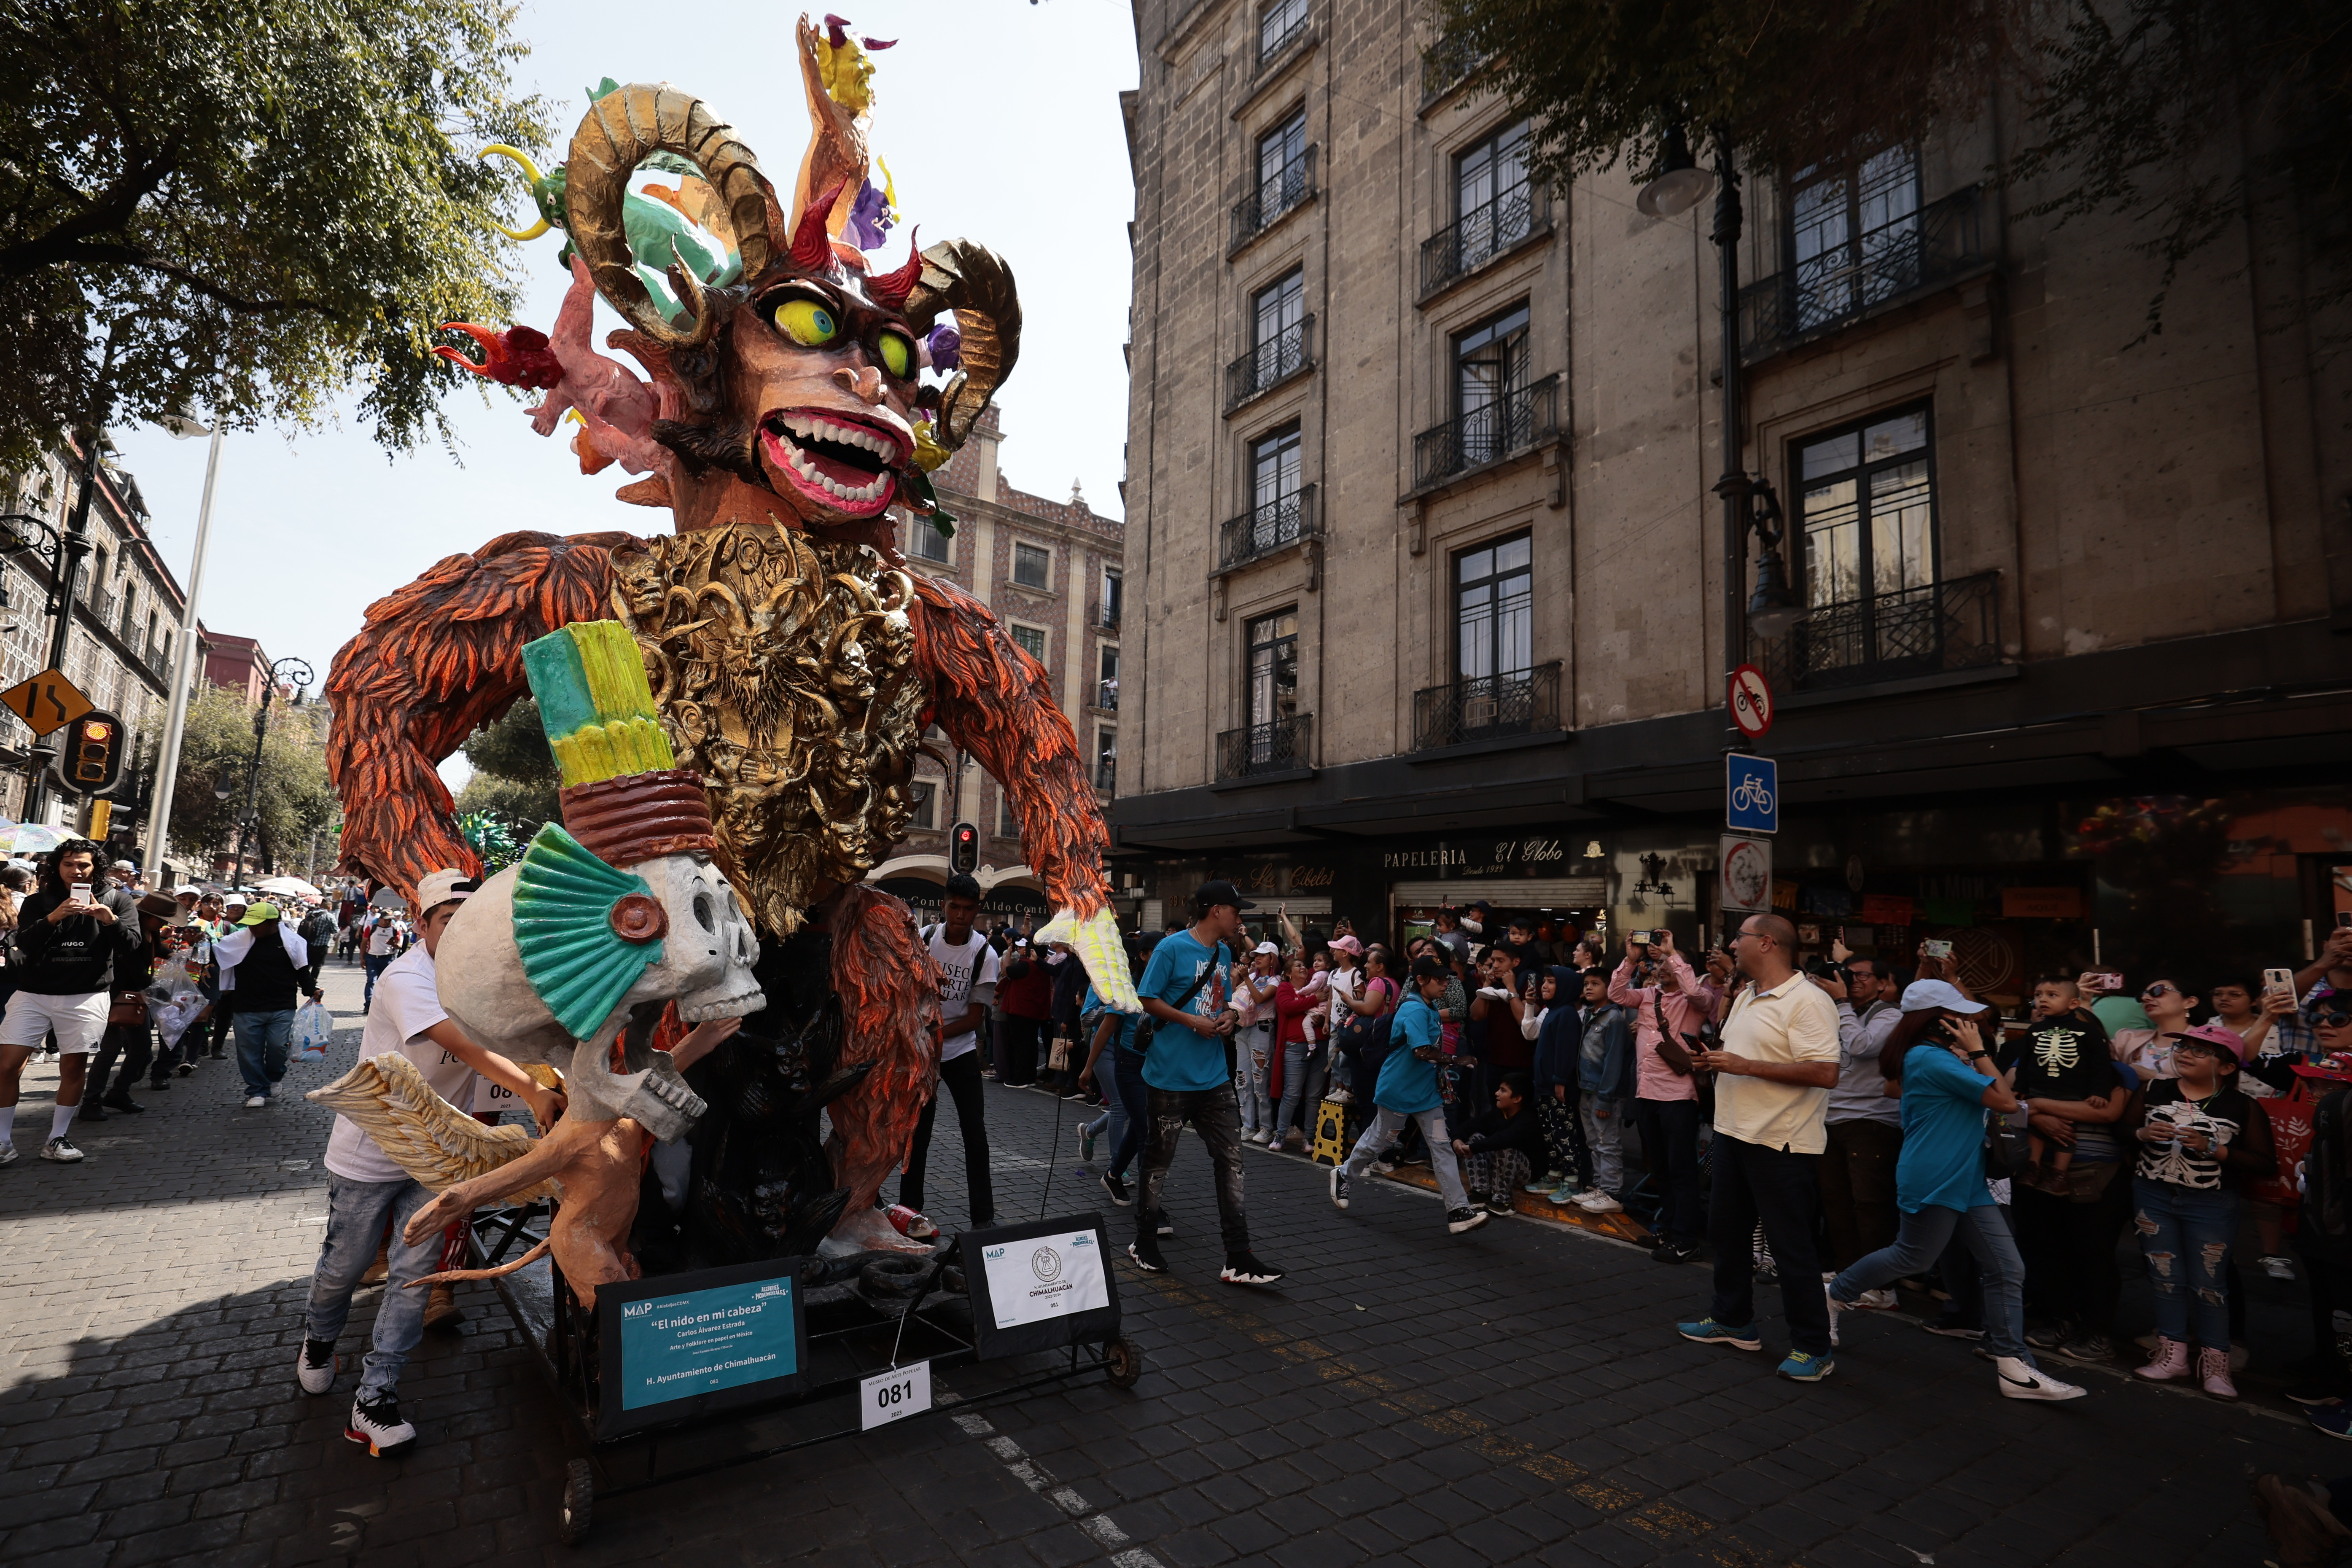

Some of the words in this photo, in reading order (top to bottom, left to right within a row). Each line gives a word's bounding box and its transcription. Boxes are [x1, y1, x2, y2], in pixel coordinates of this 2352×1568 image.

[1384, 849, 1467, 868] PAPELERIA
[1495, 840, 1517, 863] El
[1521, 839, 1564, 863] Globo
[1250, 862, 1276, 888] La
[1290, 865, 1335, 888] Cibeles
[1461, 866, 1484, 876] Desde
[1485, 864, 1504, 874] 1929
[911, 896, 941, 906] Cont
[982, 901, 1011, 911] Aldo
[1015, 904, 1047, 914] Conti
[490, 1084, 521, 1099] 08
[457, 1210, 471, 1238] adi
[986, 1248, 1004, 1259] MAP
[755, 1289, 786, 1300] MONUMENTALES
[761, 1284, 780, 1292] ALEBRIJES
[1029, 1283, 1073, 1297] CHIMALHUACÁN
[624, 1303, 652, 1317] MAP
[657, 1300, 689, 1309] #AlebrijesCDMX
[671, 1315, 694, 1327] nido
[697, 1314, 710, 1322] en
[712, 1309, 725, 1320] mi
[677, 1329, 697, 1337] Carlos
[698, 1325, 721, 1334] Álvarez
[722, 1320, 745, 1329] Estrada
[715, 1335, 729, 1343] papel
[657, 1366, 713, 1384] Ayuntamiento
[713, 1363, 723, 1371] de
[724, 1353, 776, 1369] Chimalhuacán
[868, 1378, 884, 1387] MUSEO
[903, 1366, 921, 1376] POPULAR
[878, 1380, 911, 1408] 081
